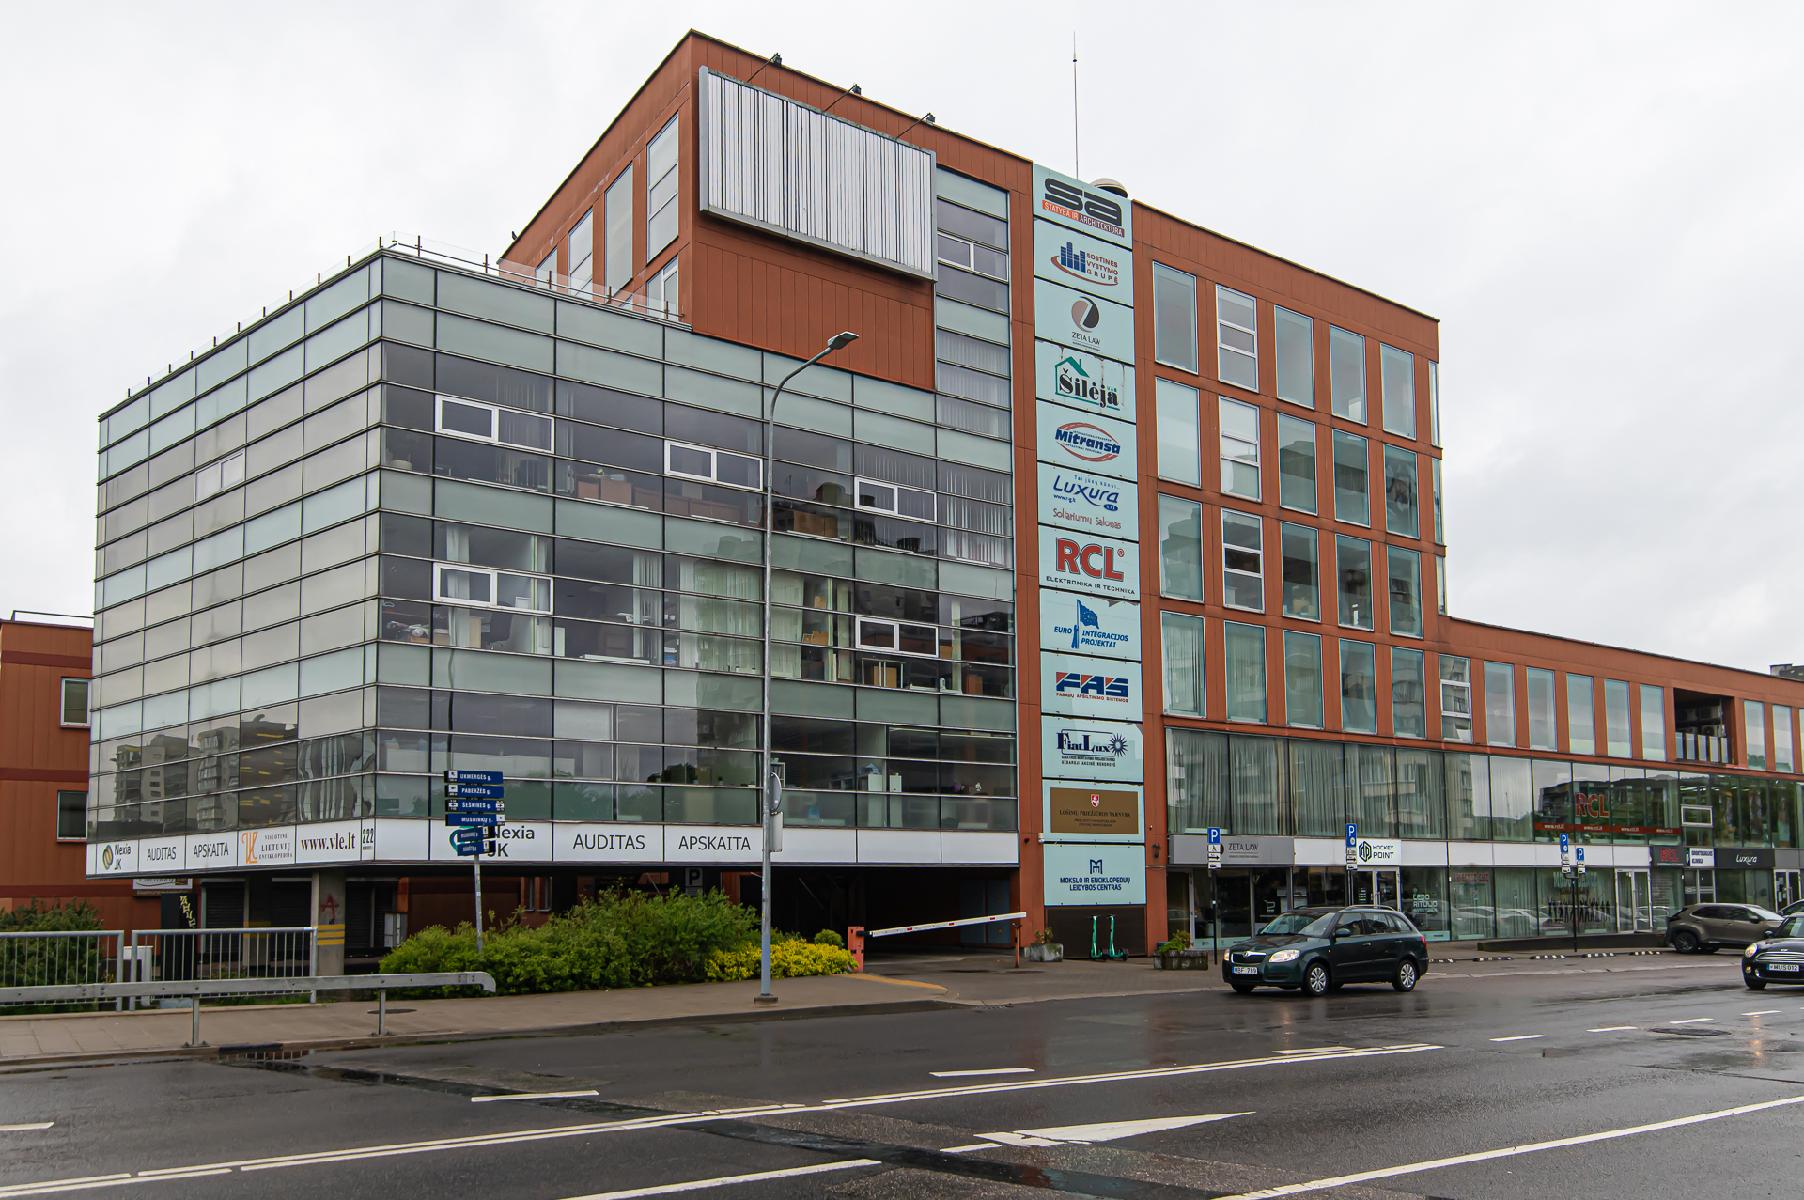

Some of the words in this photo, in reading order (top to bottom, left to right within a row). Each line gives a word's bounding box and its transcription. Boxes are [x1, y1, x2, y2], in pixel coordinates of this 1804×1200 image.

[1072, 331, 1087, 341] ZETA
[1088, 335, 1101, 345] LAW
[1059, 368, 1119, 408] Šilėja
[1055, 428, 1121, 454] Mitransa
[1053, 475, 1119, 506] Luxura
[1046, 576, 1092, 587] ELEKTRONIKA
[1103, 585, 1135, 595] TECHNIKA
[1054, 626, 1072, 634] EURO
[1081, 630, 1129, 642] INTEGRACIJOS
[1080, 637, 1116, 648] PROJEKTAI
[1575, 792, 1610, 818] RCL
[362, 828, 374, 844] 222
[1211, 829, 1218, 842] P
[1348, 825, 1354, 836] P
[301, 832, 356, 851] www.vle.lt
[573, 834, 646, 850] AUDITAS
[678, 835, 751, 850] APSKAITA
[114, 844, 132, 855] Nexia
[147, 847, 177, 861] AUDITAS
[193, 842, 229, 858] APSKAITA
[1578, 848, 1583, 859] P
[114, 860, 122, 870] JK
[1735, 854, 1758, 865] Luxura
[689, 868, 698, 882] P
